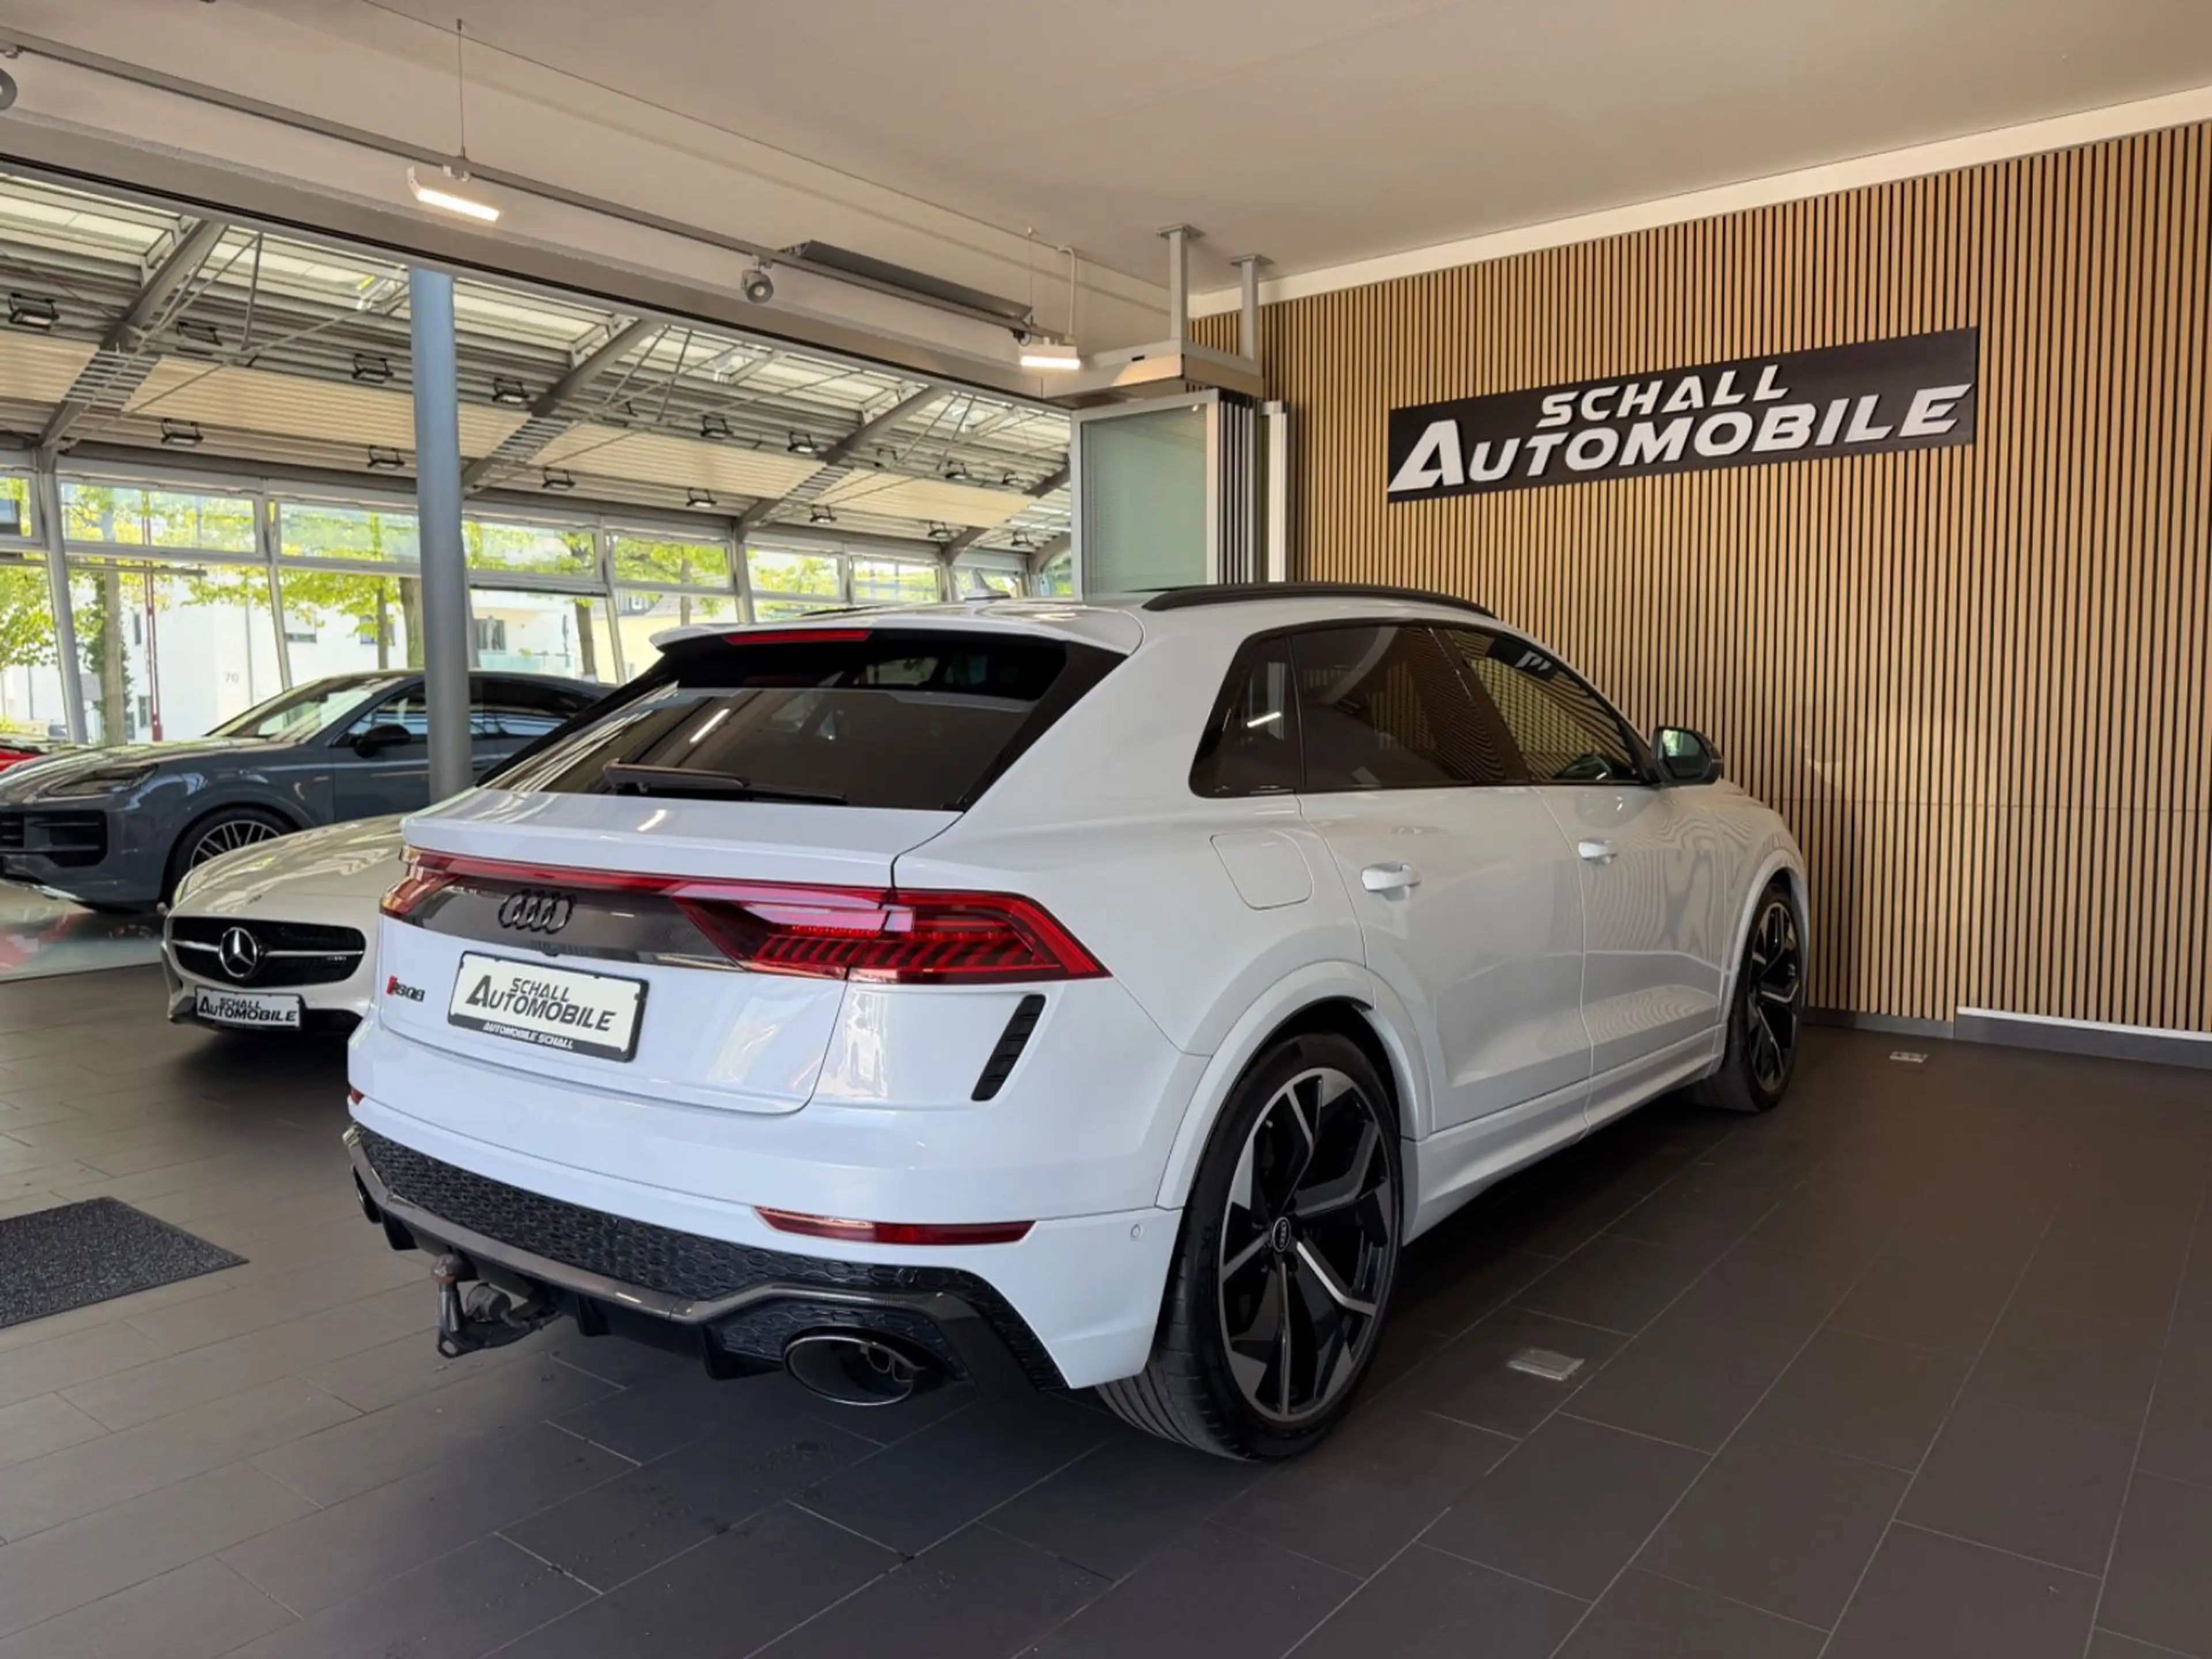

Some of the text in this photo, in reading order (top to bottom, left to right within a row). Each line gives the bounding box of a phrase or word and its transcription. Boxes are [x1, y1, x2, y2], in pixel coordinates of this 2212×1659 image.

[1536, 365, 1789, 429] SCHALL
[1387, 384, 1972, 492] AUTOMOBILE
[220, 998, 261, 1009] SCHALL
[465, 975, 616, 1031] AUTOMOBILE
[510, 978, 570, 1002] SCHALL
[199, 996, 297, 1022] AUTOMOBILE
[483, 1021, 574, 1050] AUTOMOBILE SCHALL
